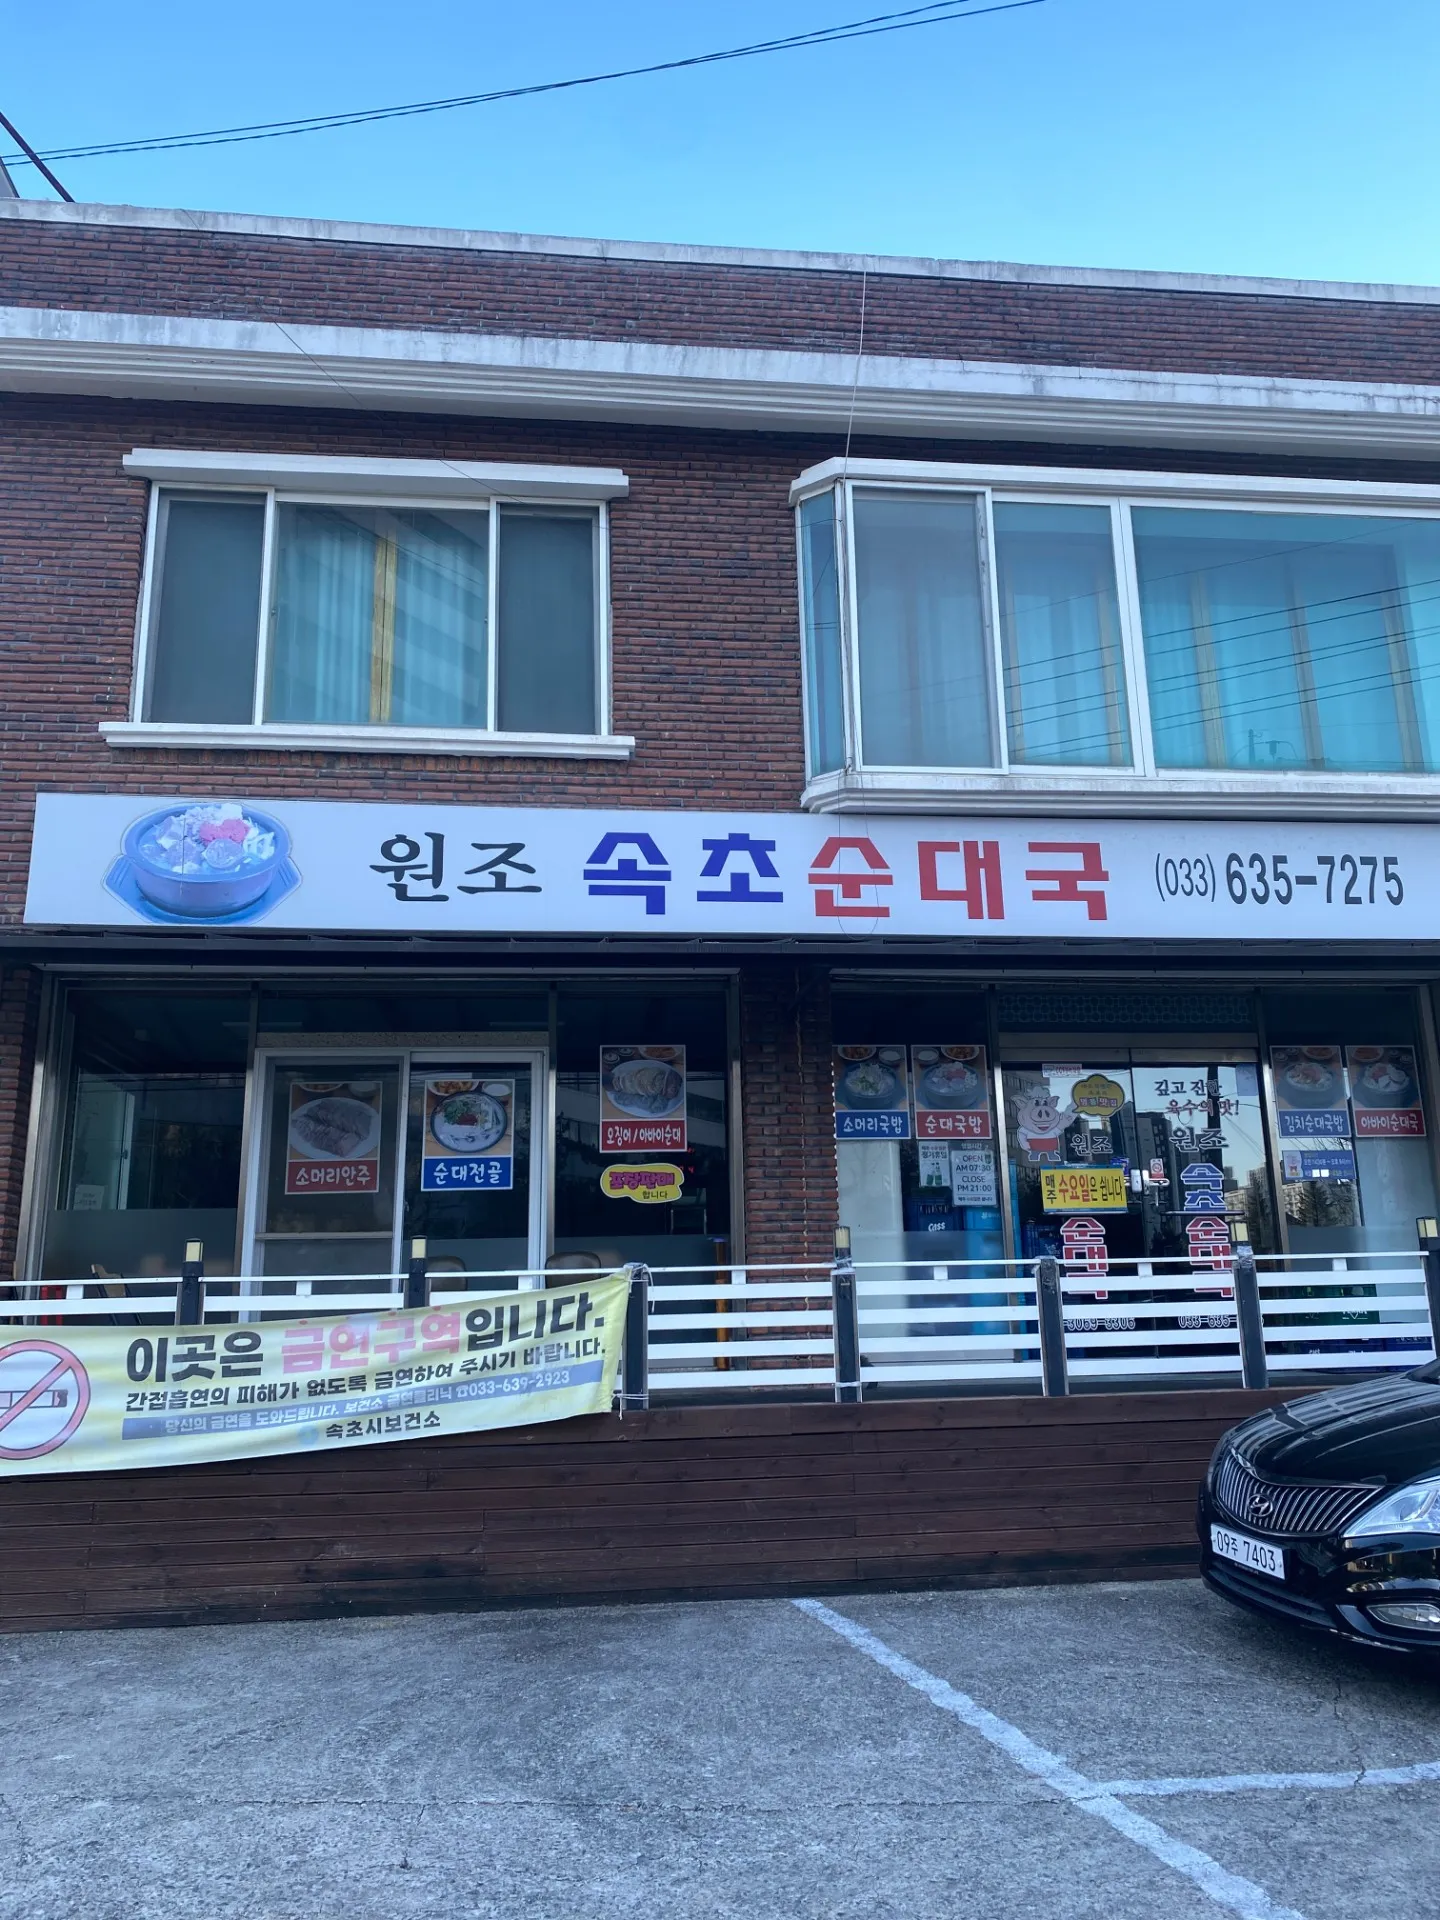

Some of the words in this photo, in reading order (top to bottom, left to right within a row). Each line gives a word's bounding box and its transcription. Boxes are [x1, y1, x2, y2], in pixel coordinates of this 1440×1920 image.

[369, 831, 542, 902] 원조
[582, 831, 784, 915] 속초
[808, 836, 1110, 921] 순대국
[1155, 852, 1216, 903] (033)
[1225, 853, 1405, 906] 635-7275
[1154, 1079, 1187, 1097] 깊고
[843, 1116, 903, 1135] 소머리국밥
[925, 1114, 983, 1135] 순대국밥
[1284, 1113, 1344, 1133] 김치순대국밥
[1361, 1112, 1418, 1132] 아바이순대국
[1070, 1134, 1113, 1156] 원조
[1168, 1126, 1230, 1153] 원조
[955, 1164, 968, 1172] AM
[962, 1154, 984, 1163] OPEN
[296, 1164, 371, 1187] 소머리안주
[433, 1161, 503, 1185] 순대전골
[609, 1170, 676, 1191] 포장판매
[961, 1175, 986, 1183] CLOSE
[642, 1190, 668, 1200] 합니다
[957, 1184, 969, 1192] PM
[970, 1184, 993, 1192] 21:00
[1058, 1173, 1096, 1203] 수요일은
[1099, 1175, 1123, 1202] 쉽니다
[1180, 1162, 1228, 1212] 속초
[126, 1330, 264, 1383] 이곳은
[125, 1386, 230, 1412] 간접흡연의
[236, 1381, 300, 1404] 피해가
[307, 1374, 367, 1397] 없도록
[374, 1363, 453, 1391] 금연하여
[459, 1350, 516, 1375] 주시기
[523, 1336, 606, 1366] 바랍니다.
[165, 1415, 207, 1433] 당신의
[210, 1412, 252, 1429] 금연을
[255, 1404, 339, 1427] 도와드립니다.
[343, 1398, 384, 1413] 보건소
[387, 1386, 452, 1408] 금연클리닉
[468, 1370, 570, 1396] 033-639-2923
[325, 1410, 441, 1439] 속초시보건소
[1216, 1530, 1239, 1557] 09주
[1243, 1540, 1276, 1572] 7403
